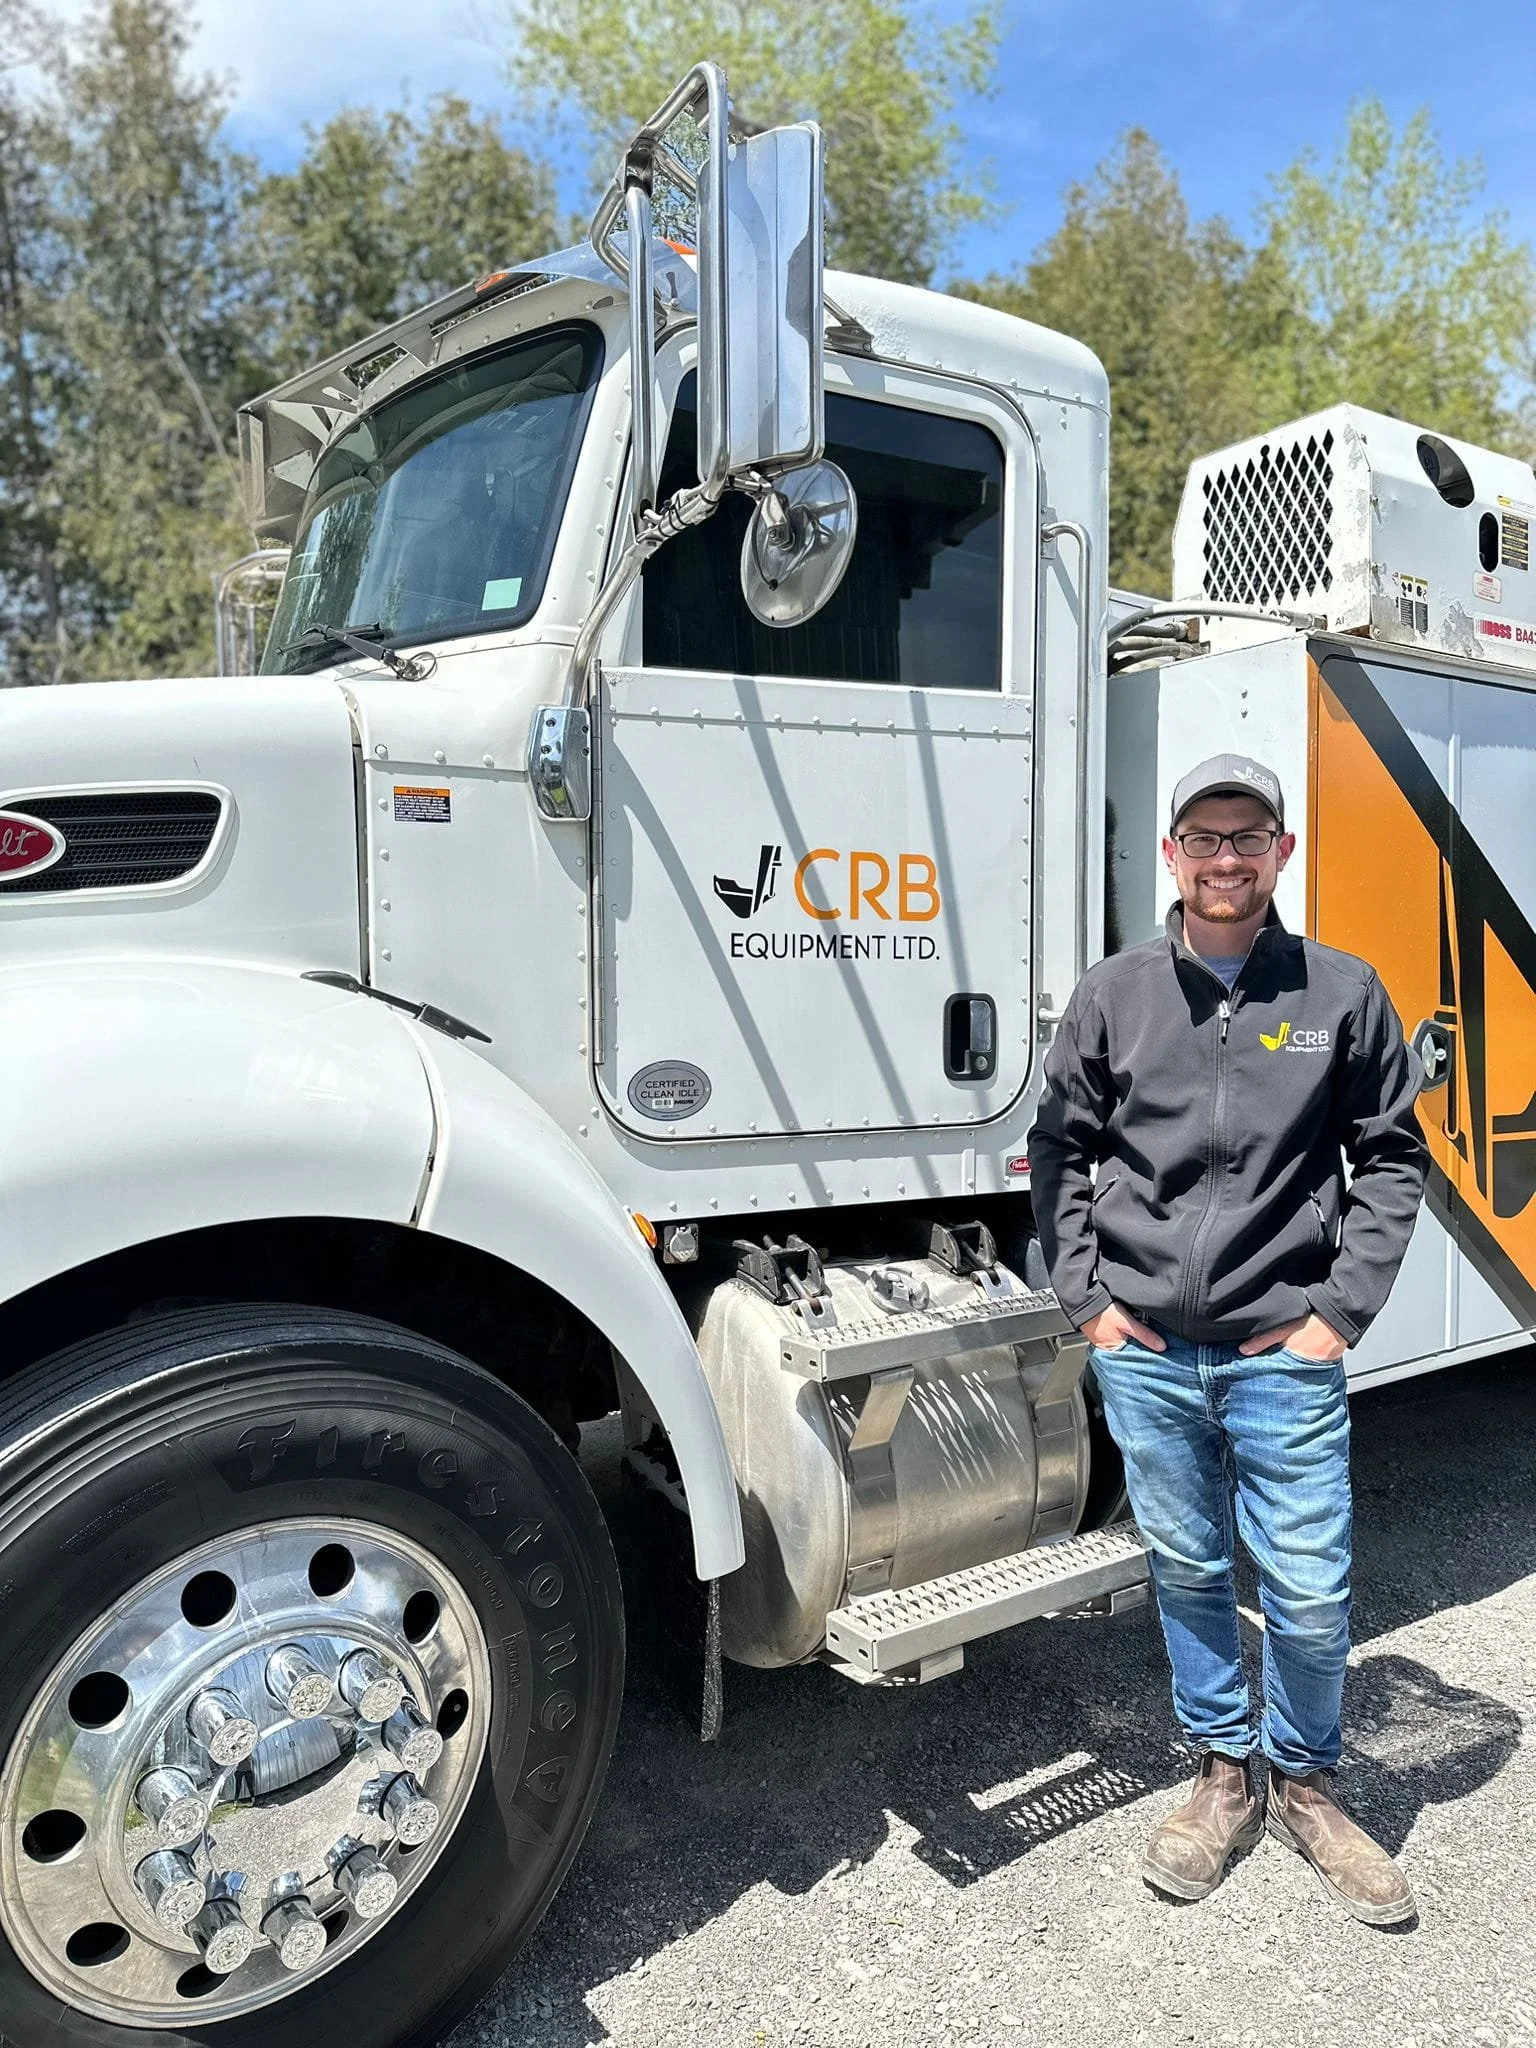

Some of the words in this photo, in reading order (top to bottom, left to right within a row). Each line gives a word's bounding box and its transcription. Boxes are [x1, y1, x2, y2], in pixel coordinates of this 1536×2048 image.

[1254, 773, 1275, 790] CRB
[794, 848, 941, 922] CRB
[730, 933, 886, 960] EQUIPMENT
[893, 936, 940, 960] LTD.
[1292, 1030, 1330, 1046] CRB
[1285, 1045, 1318, 1053] EQUIPMENT
[645, 1079, 696, 1089] CERTIFIED
[640, 1090, 675, 1099] CLEAN
[678, 1088, 700, 1098] IDLE
[237, 1419, 578, 1736] Firestone
